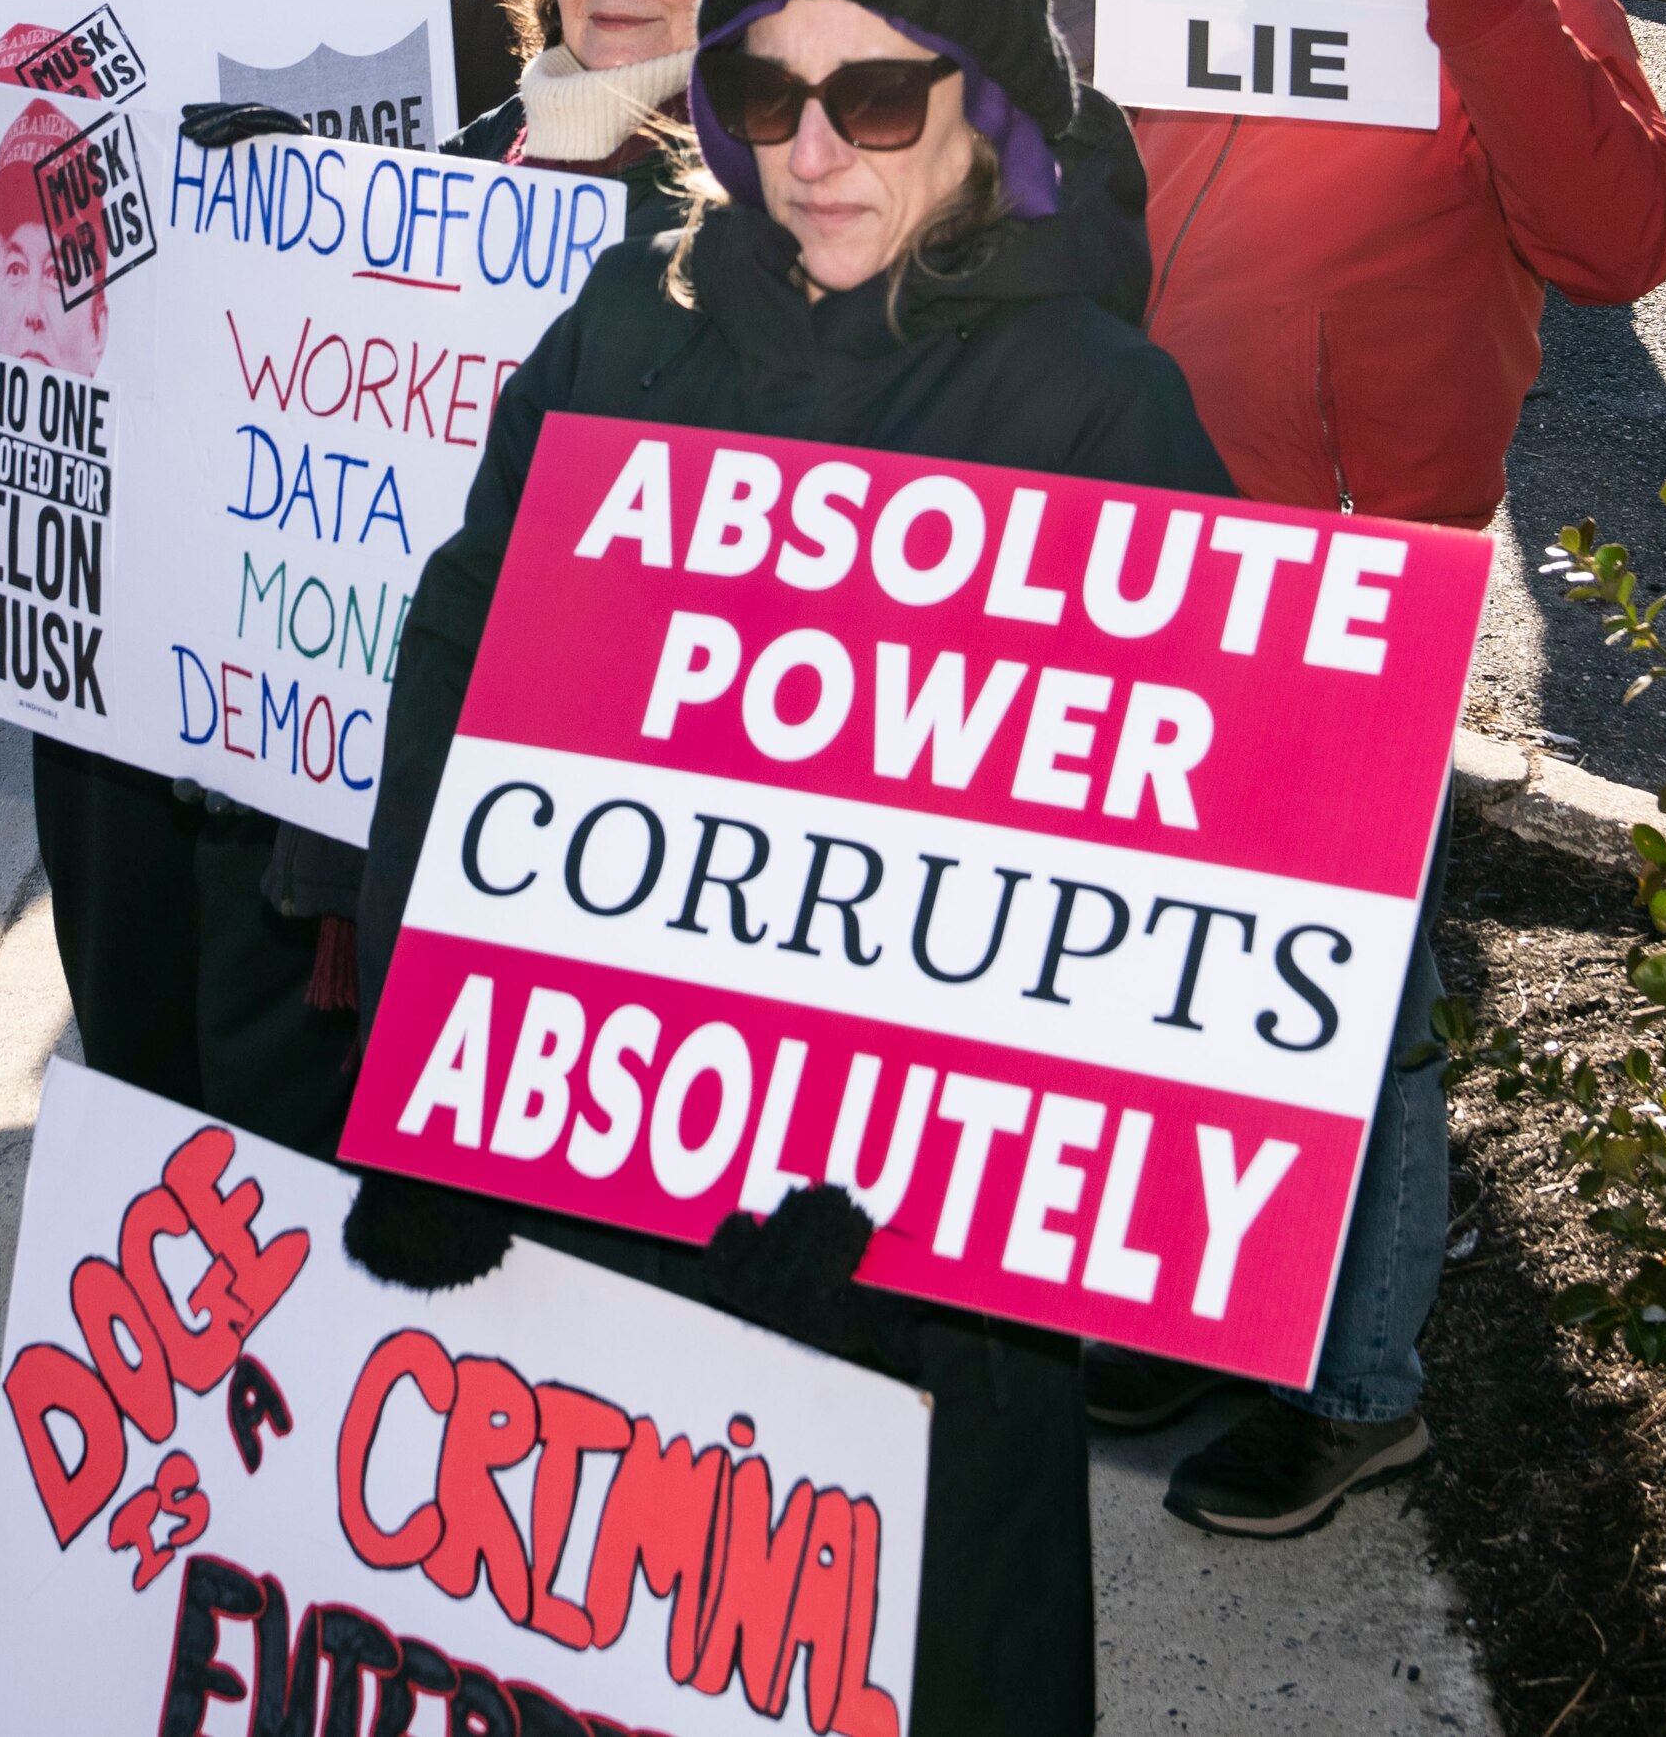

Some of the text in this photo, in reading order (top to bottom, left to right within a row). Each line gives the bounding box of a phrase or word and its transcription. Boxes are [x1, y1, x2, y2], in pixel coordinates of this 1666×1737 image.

[30, 20, 118, 91] MUSK
[91, 53, 136, 98] US
[1187, 19, 1349, 100] LIE
[46, 127, 130, 226] MUSK
[59, 191, 144, 288] OR US
[170, 124, 607, 293] HANDS OFF OUR
[39, 375, 110, 458] ONE
[59, 454, 104, 514] FOR
[227, 424, 412, 555] DATA
[574, 440, 1408, 675] ABSOLUTE
[640, 610, 1216, 832] POWER
[459, 782, 1353, 1052] CORRUPTS
[397, 974, 1301, 1322] ABSOLUTELY
[3, 1125, 312, 1552] DOGE
[106, 1354, 293, 1593] IS A
